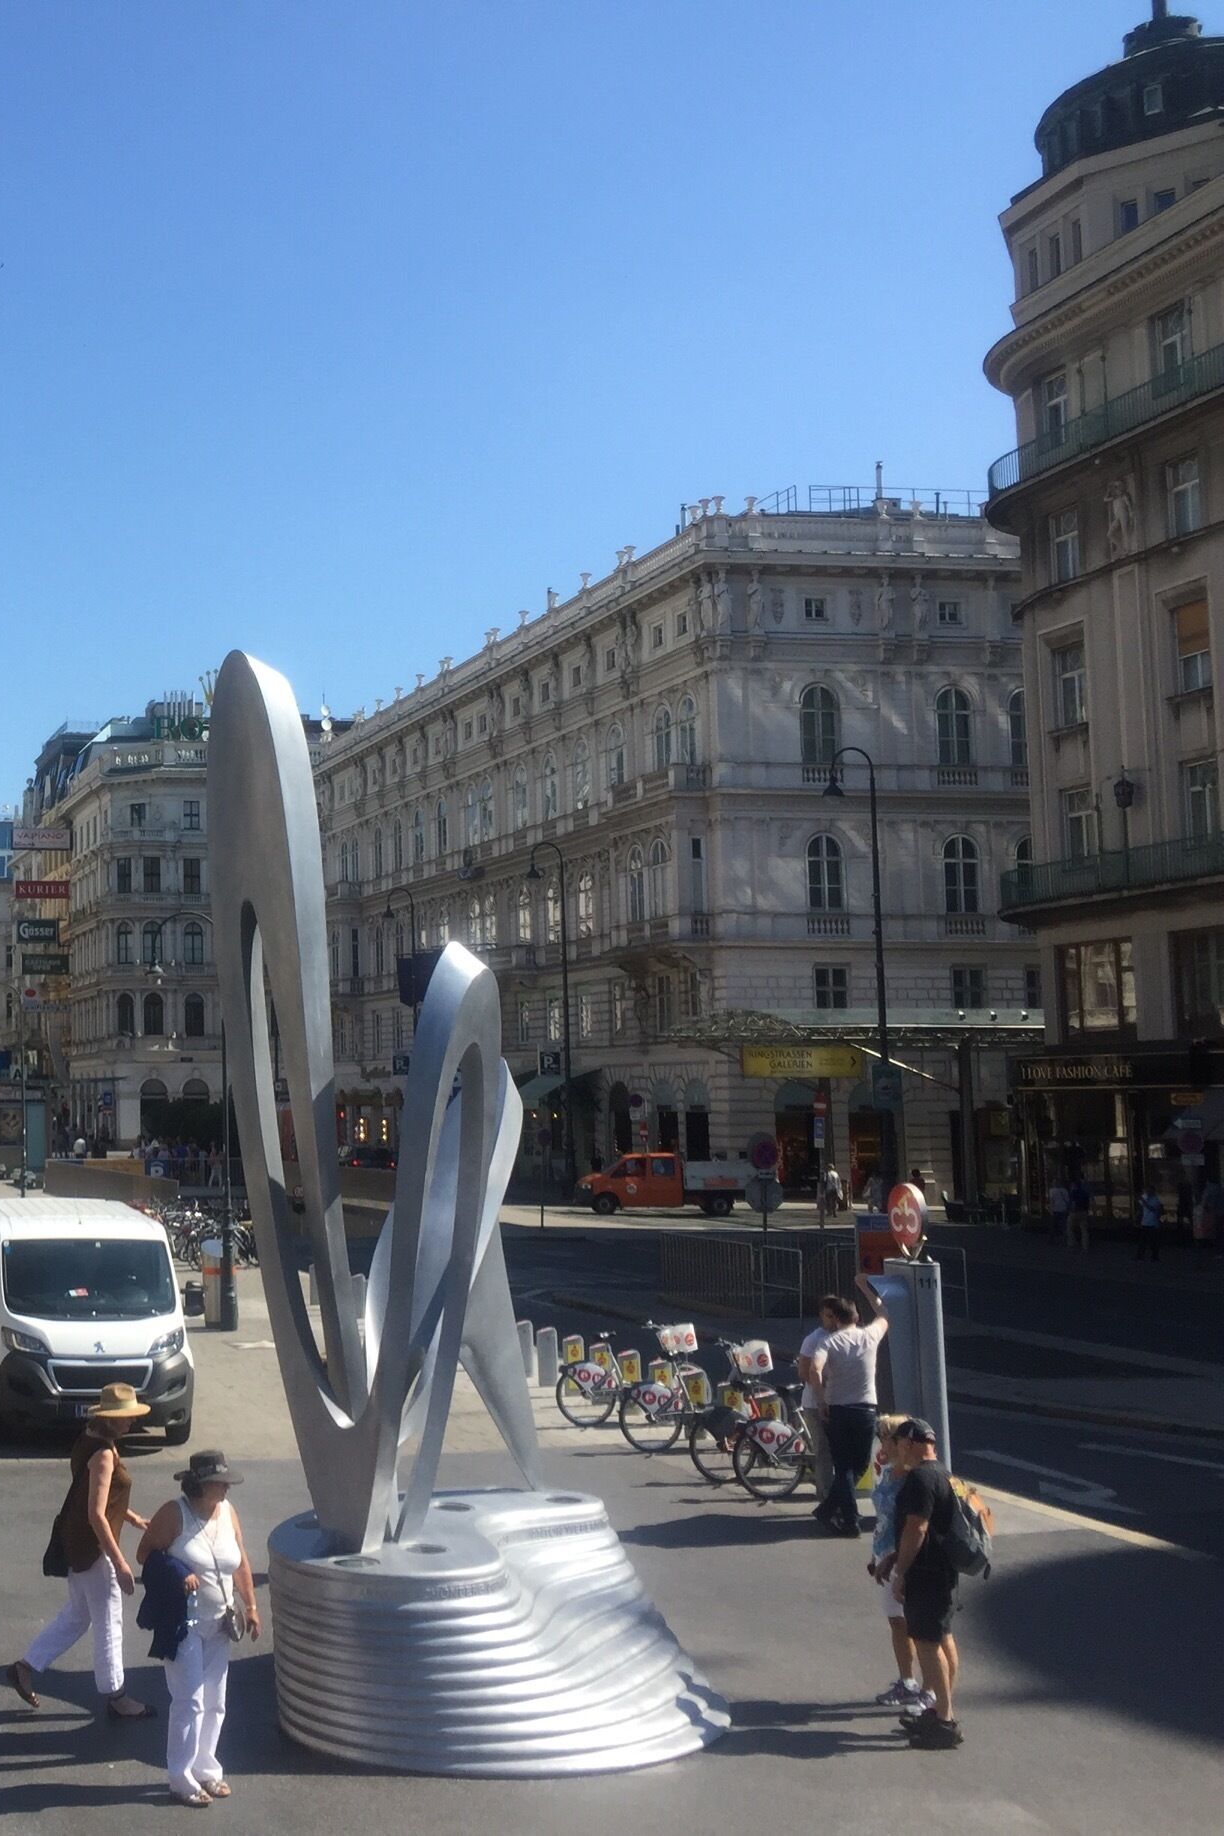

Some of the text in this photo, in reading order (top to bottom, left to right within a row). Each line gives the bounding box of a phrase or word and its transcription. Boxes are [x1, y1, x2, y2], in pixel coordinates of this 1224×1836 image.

[17, 832, 65, 840] VAPIANO
[18, 885, 66, 894] KURIER
[19, 922, 55, 939] Gösser
[543, 1055, 554, 1069] P
[769, 1059, 813, 1069] GALERIEN
[1056, 1064, 1102, 1079] FASHION
